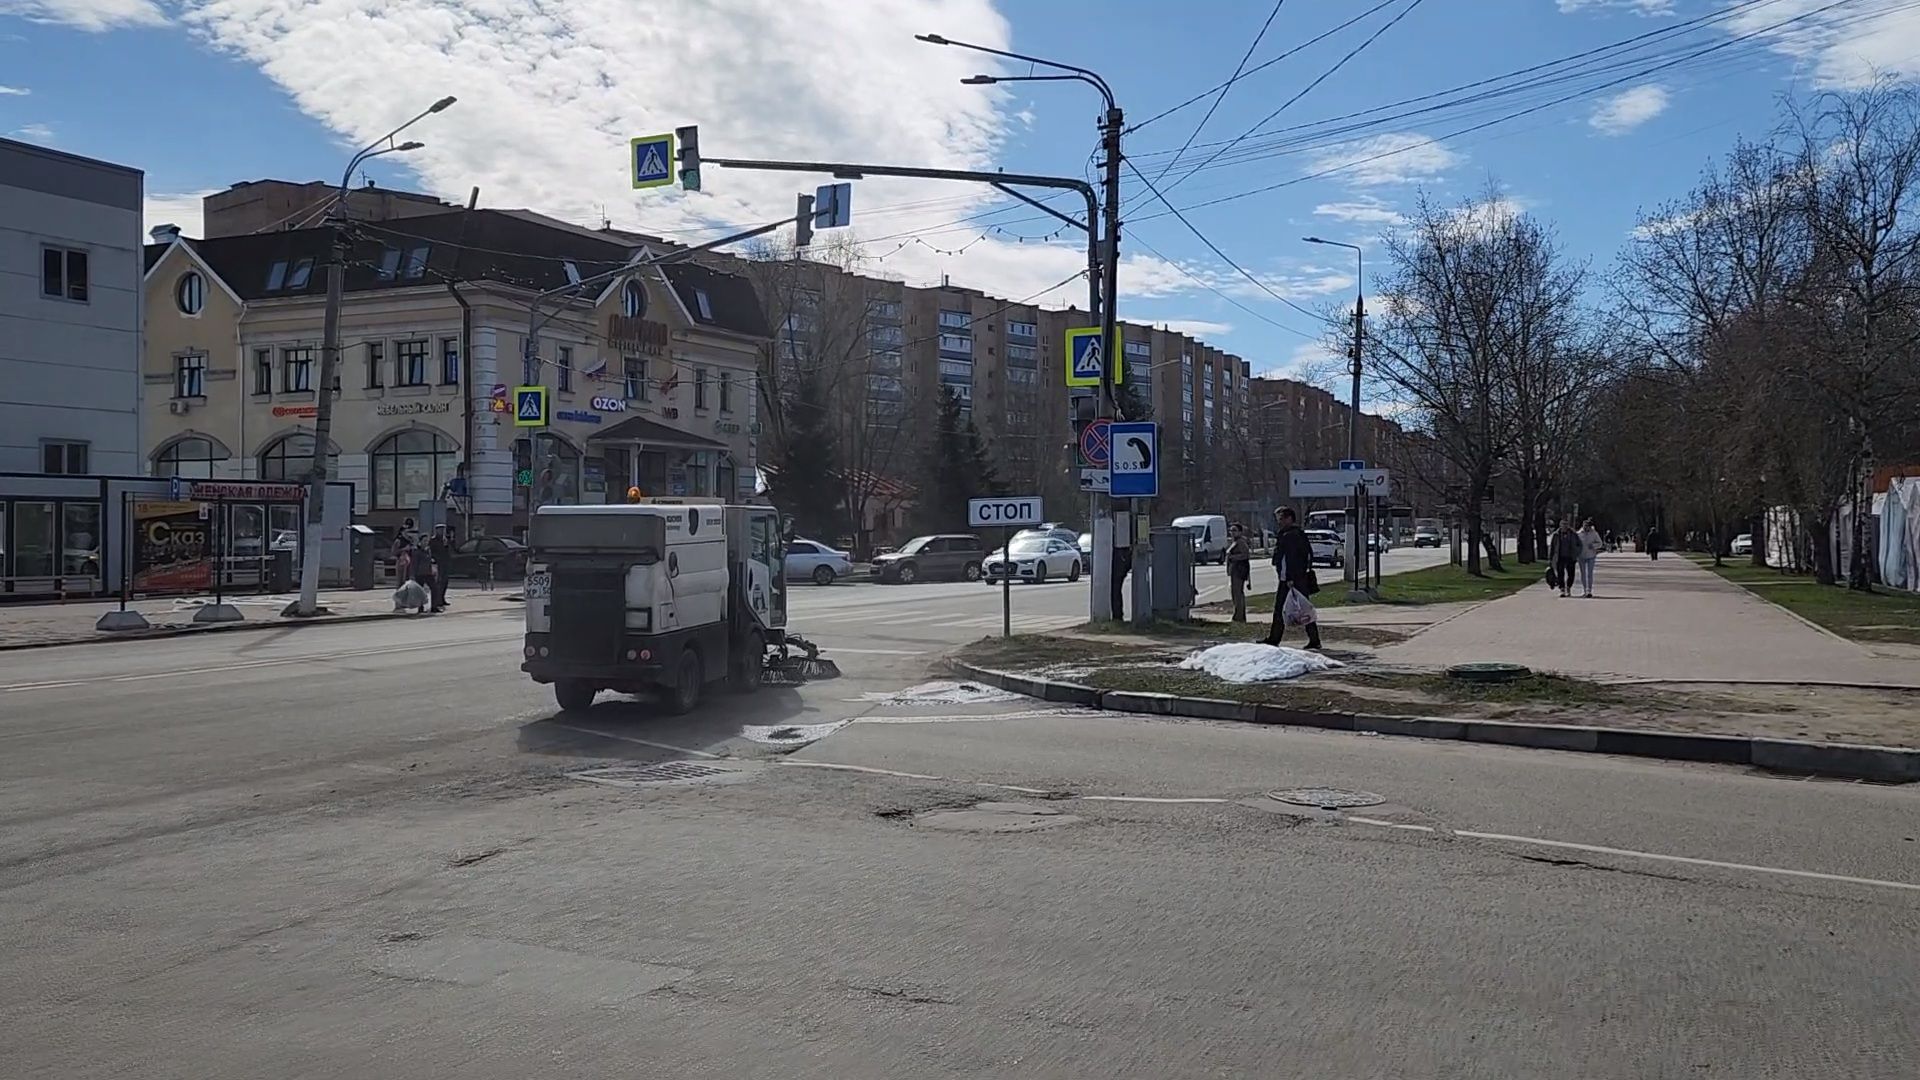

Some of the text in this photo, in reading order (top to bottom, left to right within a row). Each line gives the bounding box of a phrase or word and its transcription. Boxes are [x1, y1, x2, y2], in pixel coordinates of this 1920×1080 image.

[593, 397, 626, 411] OZON
[191, 485, 309, 499] ЖЕНСКАЯ ОДЕЖДА
[979, 503, 1032, 520] СТОП
[149, 521, 206, 545] Сказ
